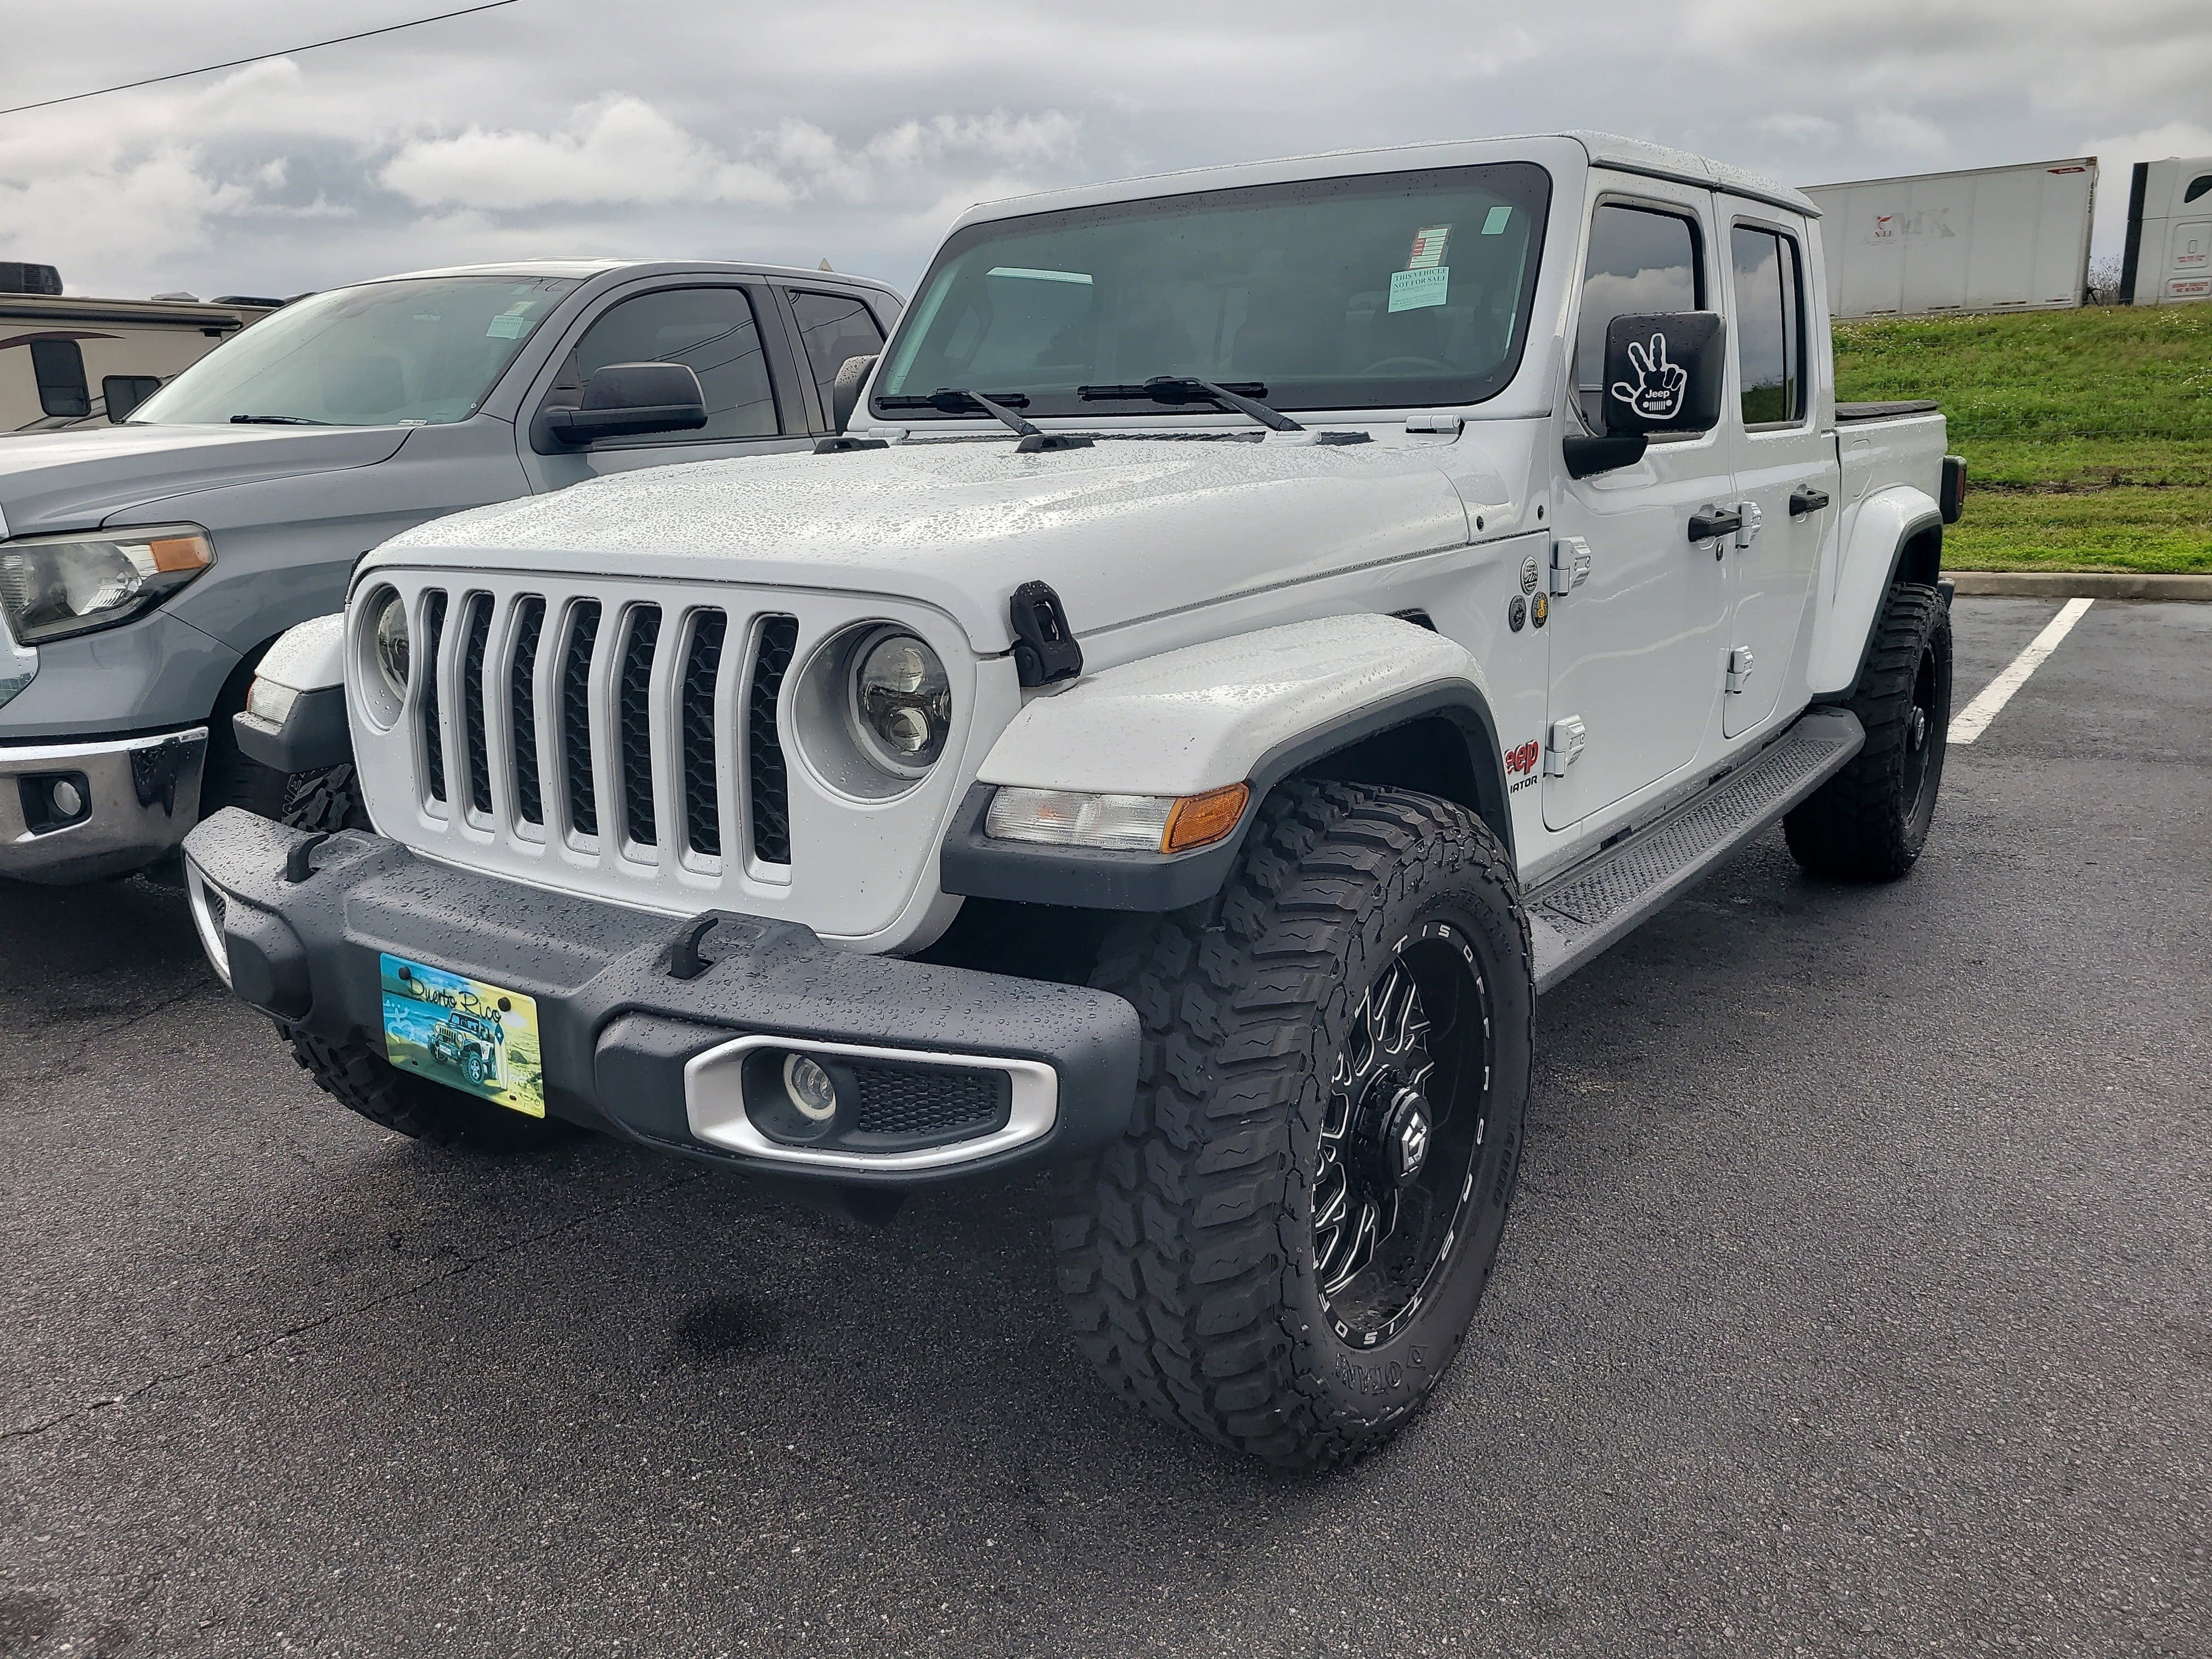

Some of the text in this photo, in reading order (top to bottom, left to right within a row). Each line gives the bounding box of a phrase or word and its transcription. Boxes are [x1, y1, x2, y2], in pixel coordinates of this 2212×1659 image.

[1414, 268, 1446, 277] VEHICLE
[1645, 390, 1670, 398] Jeep
[1504, 740, 1539, 775] eep
[408, 977, 501, 1022] Puerto Rico
